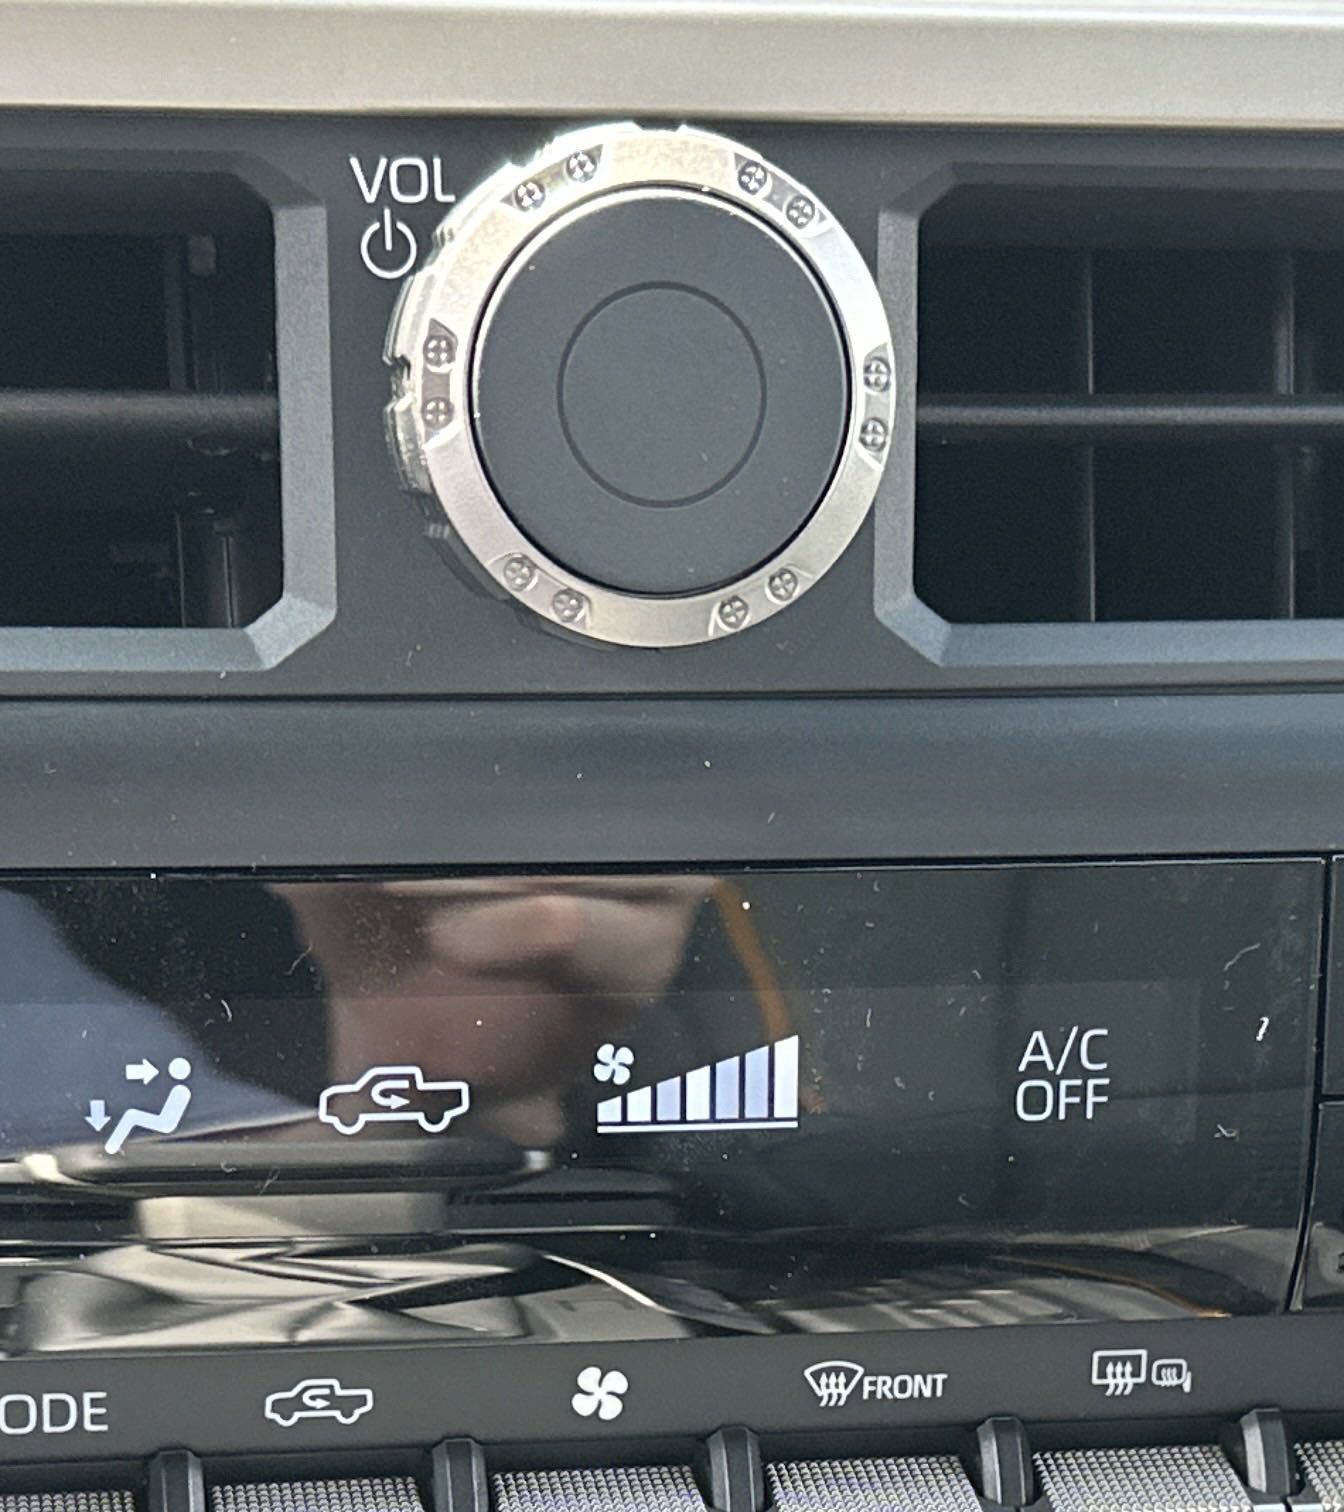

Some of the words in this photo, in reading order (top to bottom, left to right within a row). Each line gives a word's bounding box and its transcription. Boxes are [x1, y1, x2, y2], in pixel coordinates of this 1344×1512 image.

[350, 157, 457, 203] VOL
[1018, 1026, 1108, 1074] A/C
[1016, 1078, 1109, 1121] OFF
[863, 1374, 948, 1400] FRONT
